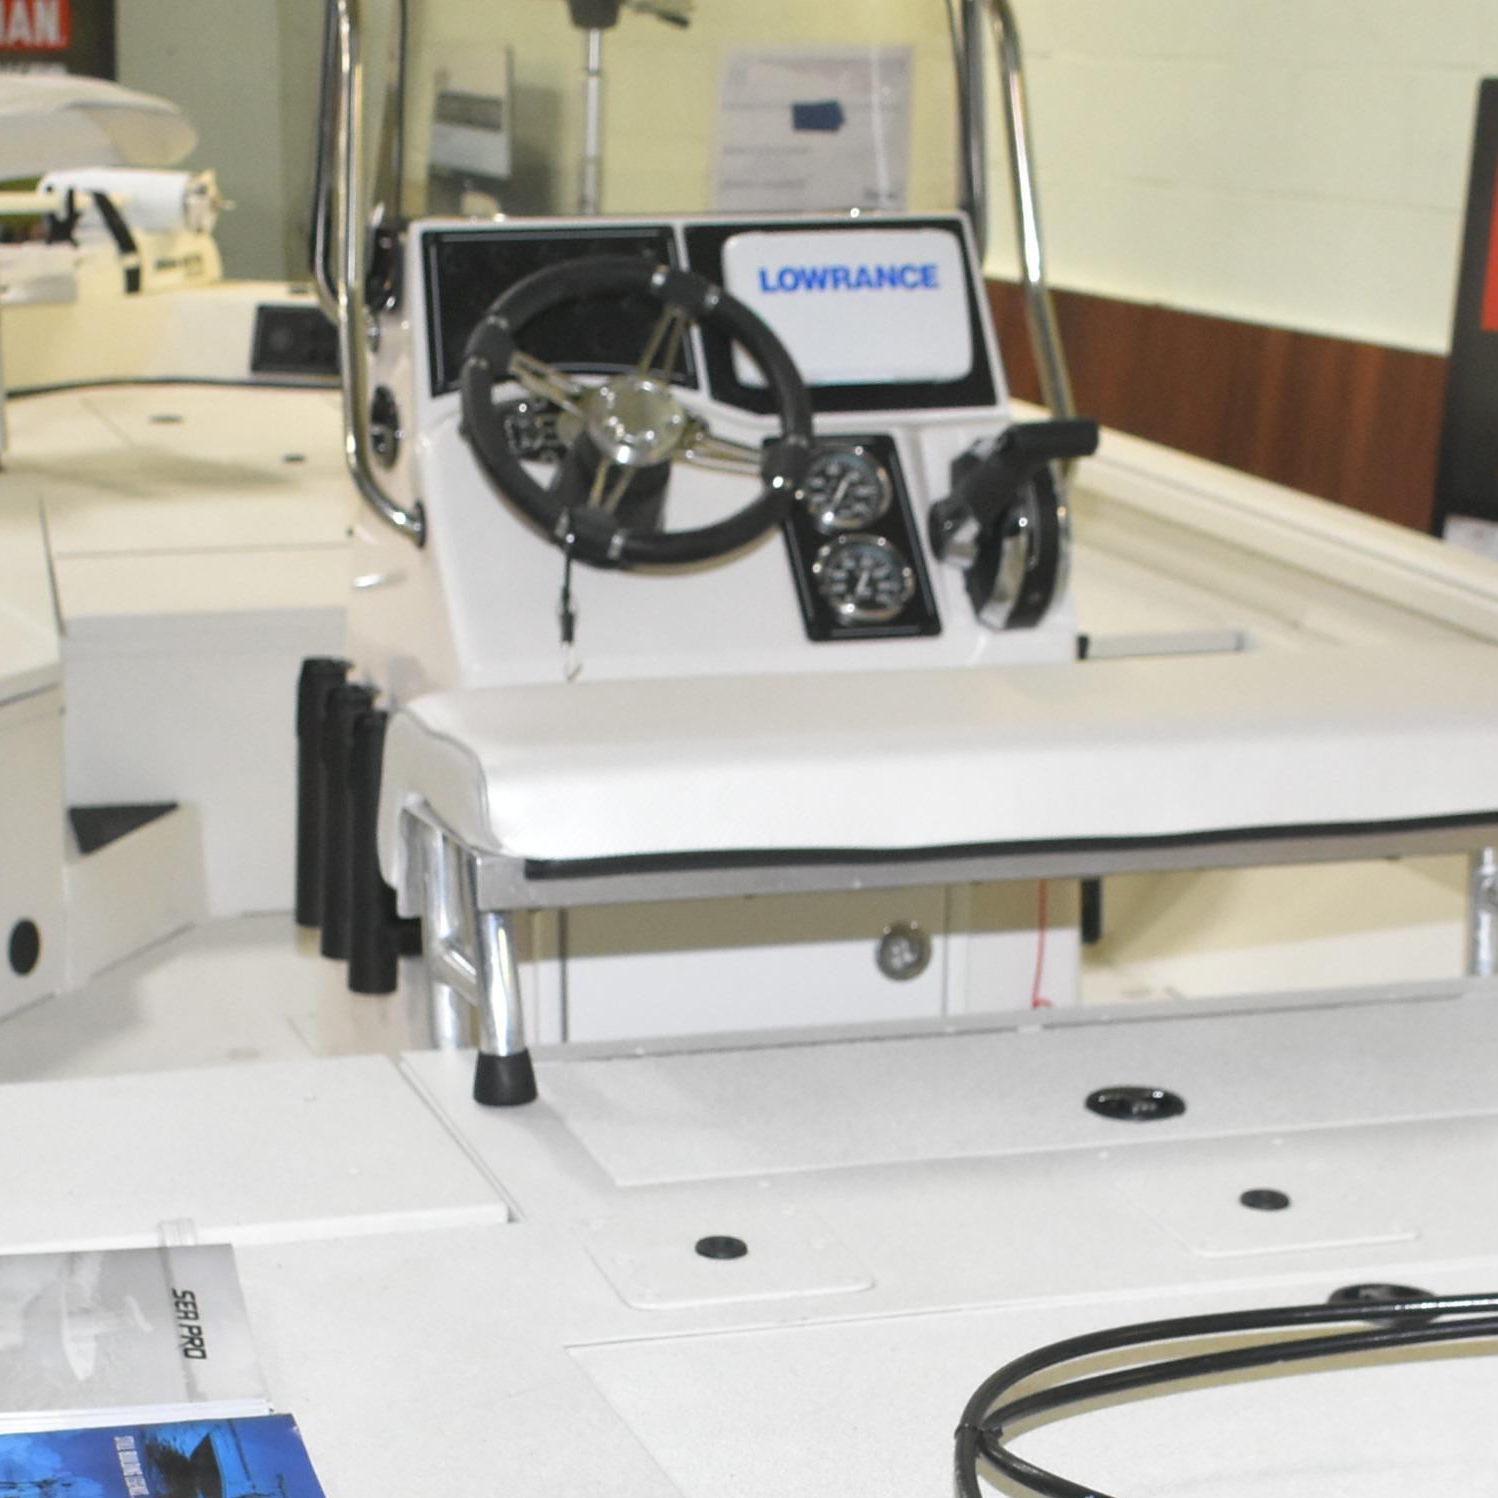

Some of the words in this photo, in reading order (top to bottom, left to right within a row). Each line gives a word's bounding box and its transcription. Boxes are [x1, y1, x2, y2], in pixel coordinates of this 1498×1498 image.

[758, 263, 940, 293] LOWRANCE
[172, 1287, 199, 1321] SEA
[179, 1323, 208, 1360] PRO
